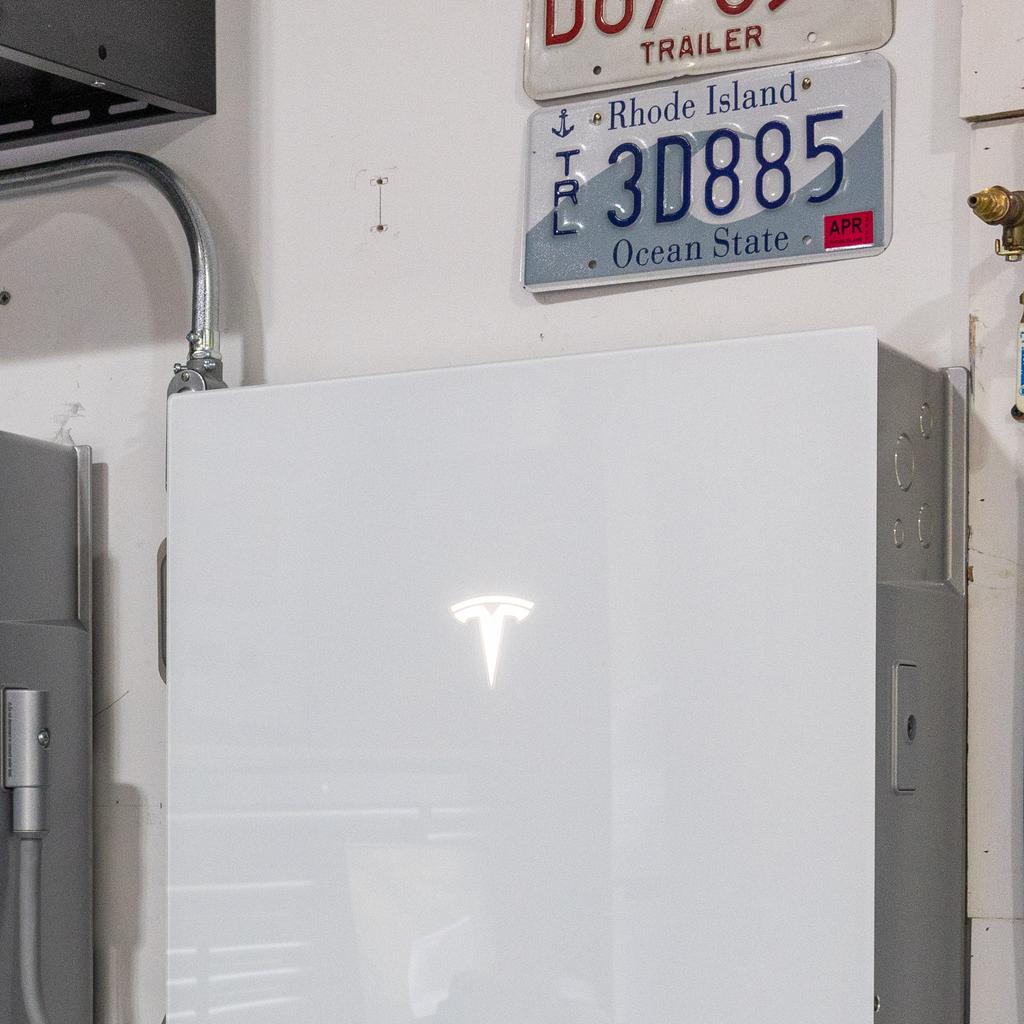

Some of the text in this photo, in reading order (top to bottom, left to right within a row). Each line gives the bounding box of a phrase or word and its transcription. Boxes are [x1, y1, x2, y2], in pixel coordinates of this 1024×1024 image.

[640, 25, 763, 64] TRAILER
[607, 71, 798, 131] Rhode Island
[552, 148, 581, 237] TRL
[607, 109, 845, 229] 3D885
[612, 226, 790, 270] Ocean State
[829, 216, 863, 236] APR
